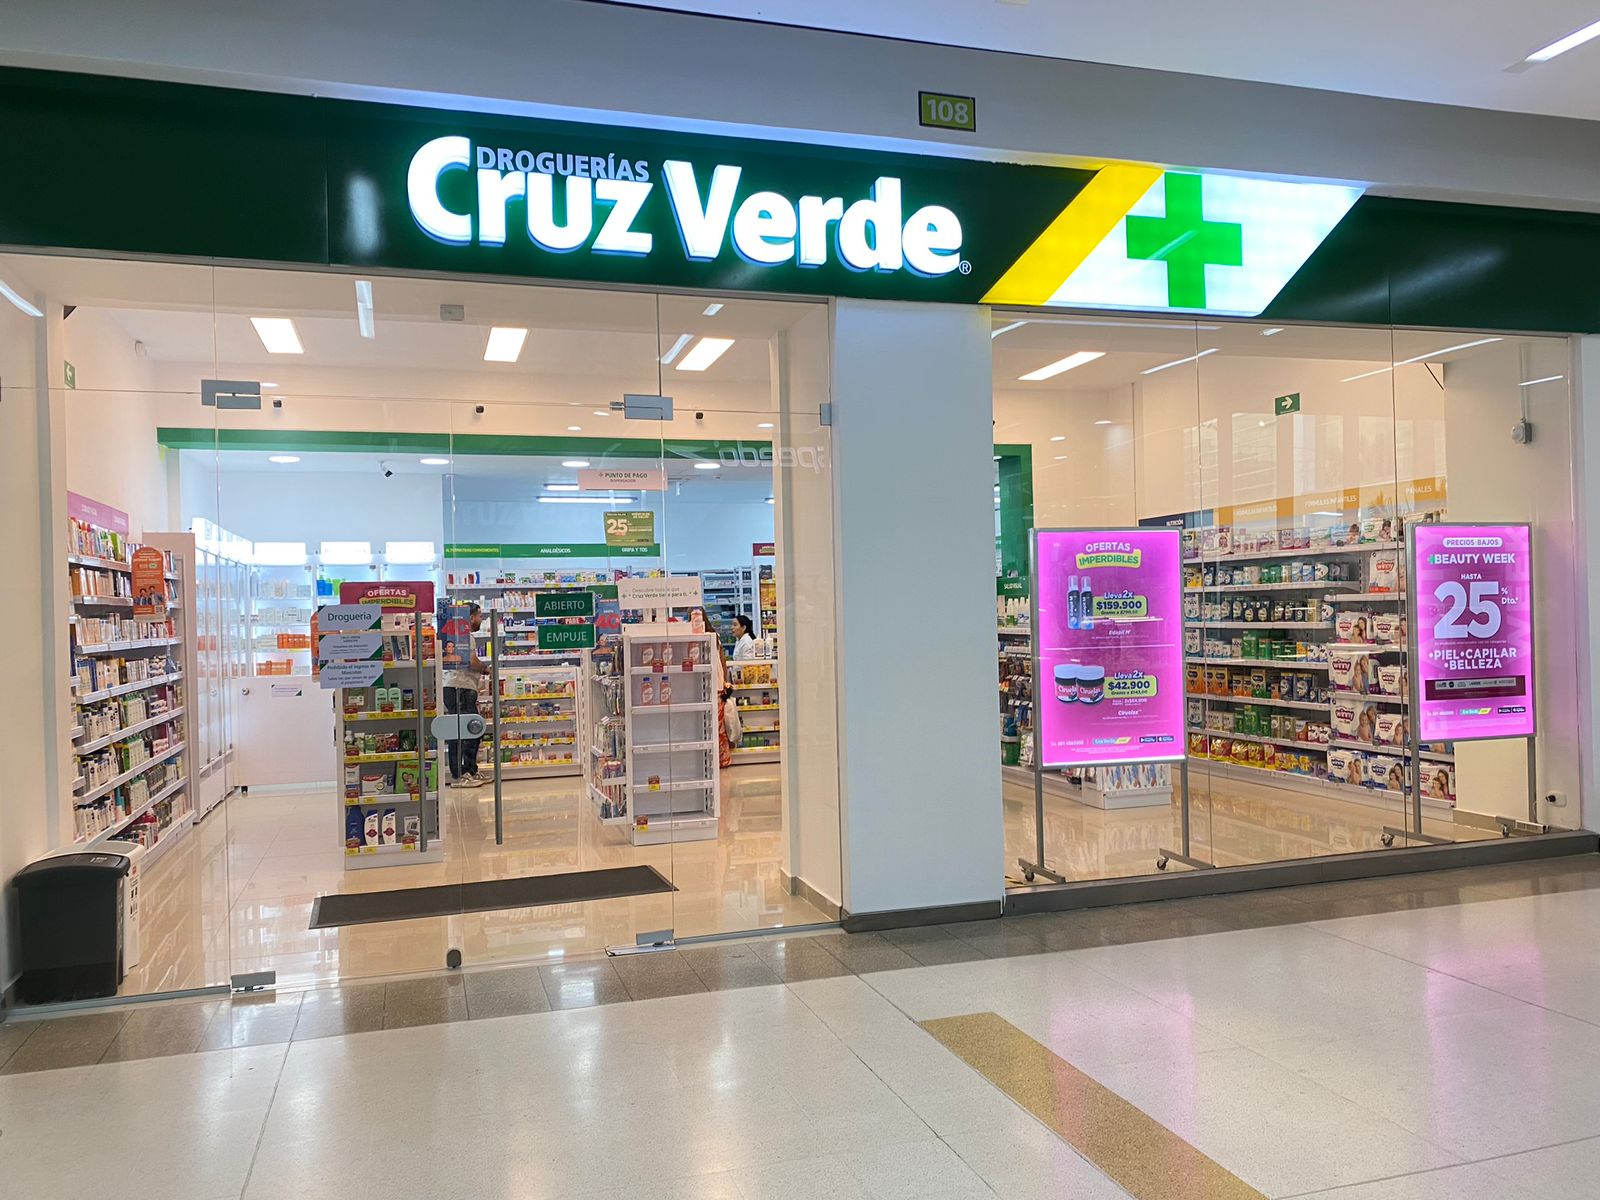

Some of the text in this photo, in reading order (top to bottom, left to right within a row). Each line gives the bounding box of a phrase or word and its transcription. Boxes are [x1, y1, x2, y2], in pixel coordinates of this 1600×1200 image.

[927, 98, 969, 125] 108
[476, 146, 650, 183] DROGUERÍAS
[406, 135, 654, 257] Cruz
[632, 471, 648, 479] PAGO
[606, 518, 628, 534] 25
[1085, 541, 1131, 553] OFERTAS
[1079, 554, 1139, 566] IMPERDIBLES
[1434, 553, 1515, 564] BEAUTY WEEK
[1376, 561, 1395, 571] winny
[367, 588, 407, 597] OFERTAS
[1104, 589, 1134, 600] Lleva 2x
[1501, 587, 1509, 595] %
[544, 600, 585, 611] ABIERTO
[1096, 600, 1142, 610] $159.900
[1433, 580, 1502, 639] 25
[546, 631, 587, 644] EMPUJE
[1434, 647, 1517, 660] PIEL CAPILAR
[1332, 660, 1351, 672] winny
[1449, 658, 1502, 670] BELLEZA
[1114, 669, 1144, 680] Lleva 2x
[1107, 680, 1151, 691] $42.900
[1335, 710, 1355, 722] winny
